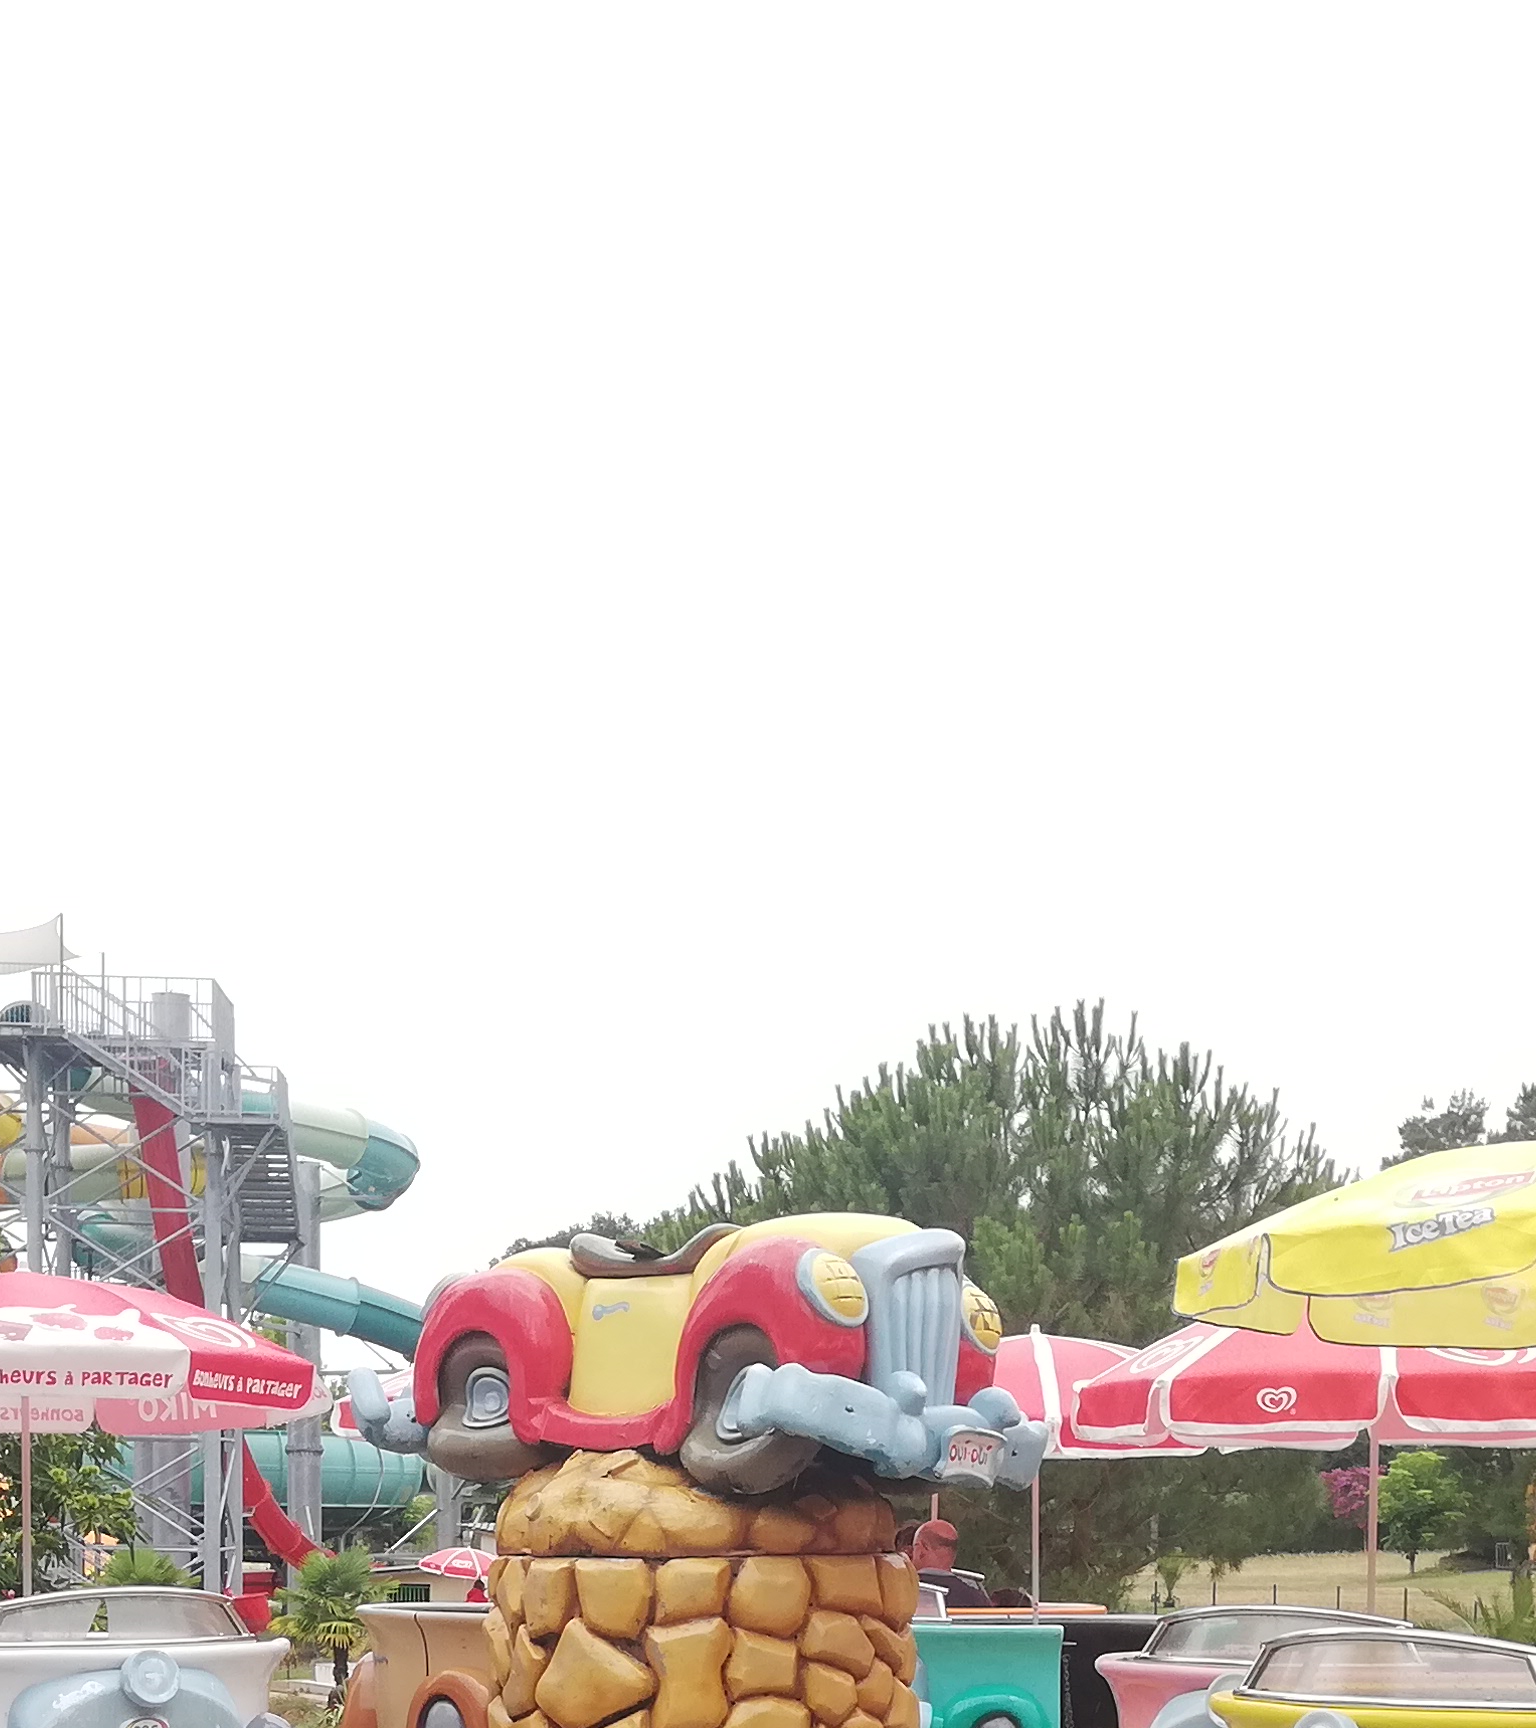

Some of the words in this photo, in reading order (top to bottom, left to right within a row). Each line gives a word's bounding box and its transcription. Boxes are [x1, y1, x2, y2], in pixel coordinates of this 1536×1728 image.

[1421, 1174, 1526, 1198] Lipton
[1390, 1220, 1440, 1250] Ice
[1438, 1207, 1494, 1236] Tea
